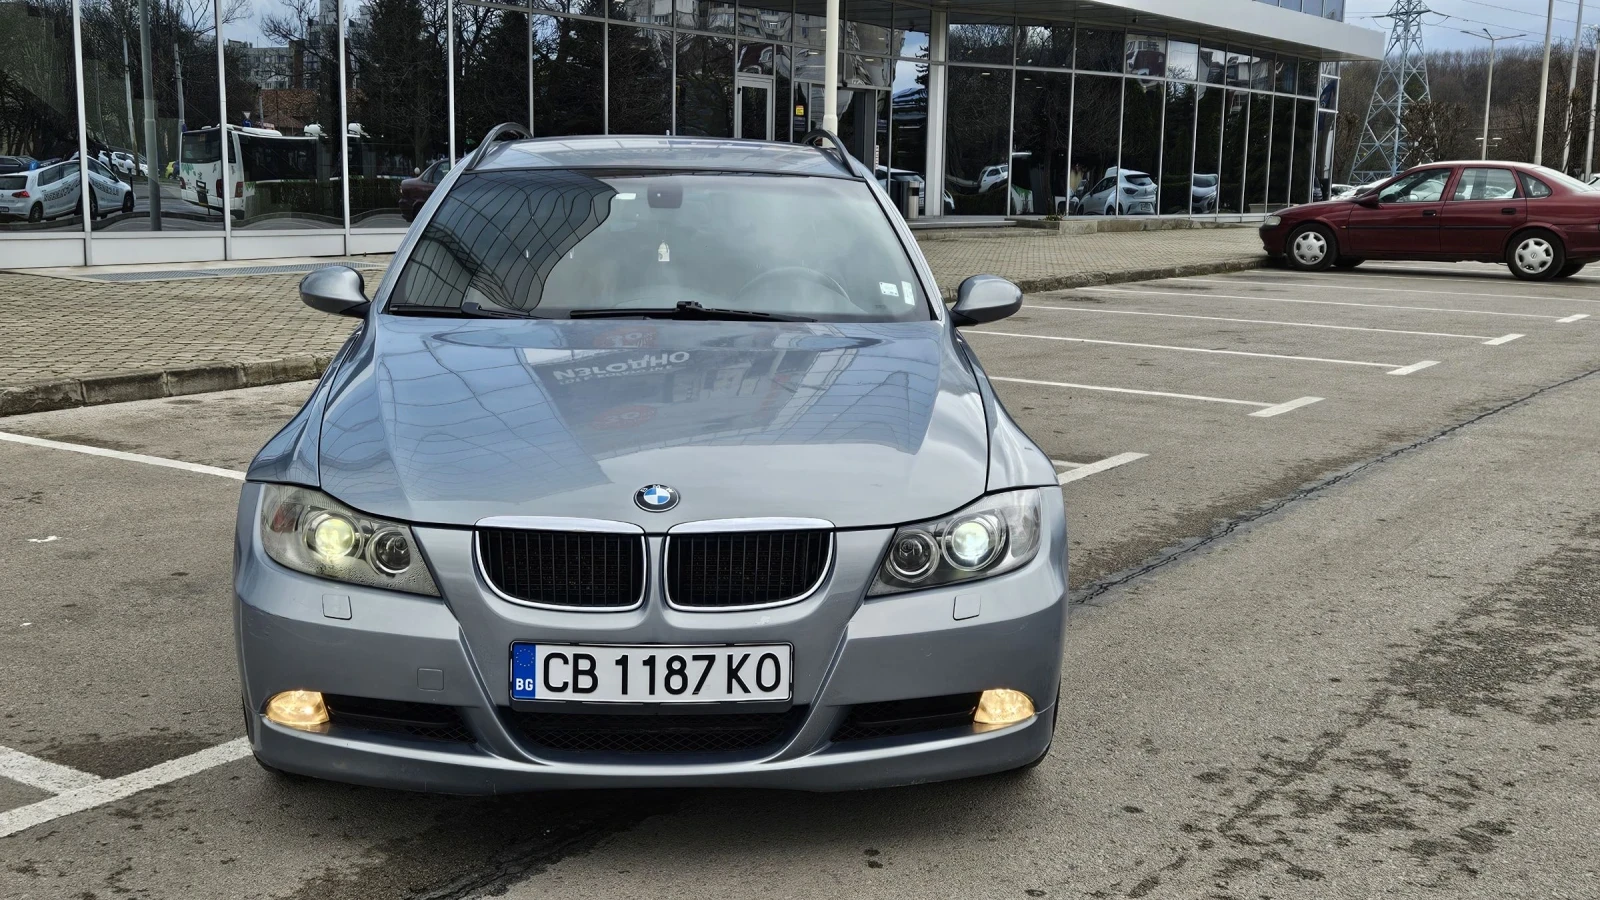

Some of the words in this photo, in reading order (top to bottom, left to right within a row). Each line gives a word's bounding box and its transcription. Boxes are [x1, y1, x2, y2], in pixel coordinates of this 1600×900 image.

[515, 678, 534, 691] BG
[543, 652, 599, 694] CB
[615, 654, 716, 695] 1187
[726, 652, 781, 693] KO
